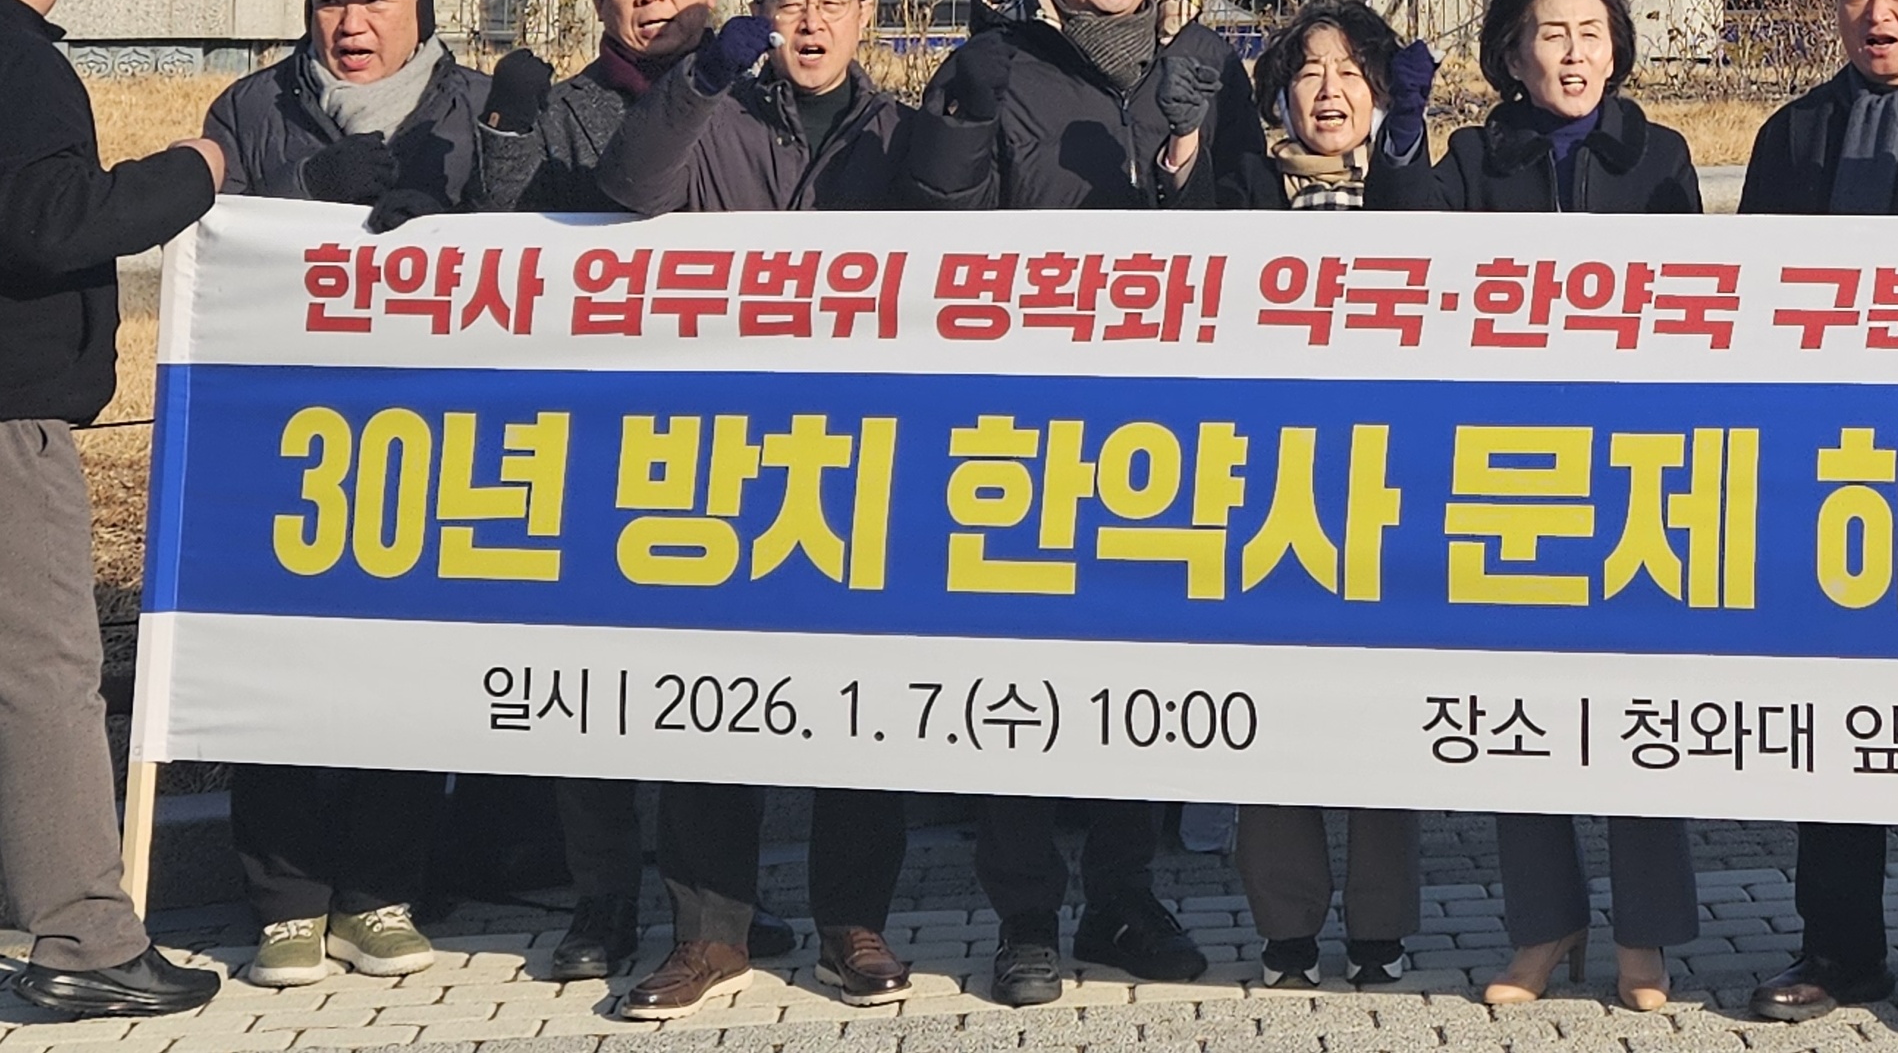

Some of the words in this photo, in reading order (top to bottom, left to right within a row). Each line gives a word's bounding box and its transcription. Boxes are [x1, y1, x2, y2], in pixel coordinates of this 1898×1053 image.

[305, 244, 543, 334] 한약사
[572, 250, 906, 338] 업무범위
[935, 253, 1226, 342] 명확화!
[275, 406, 568, 579] 30년
[618, 414, 895, 588] 방치
[949, 415, 1399, 599] 한약사
[1446, 425, 1757, 607] 문제
[484, 668, 588, 733] 일시
[655, 675, 811, 738] 2026.
[841, 681, 884, 740] 1.
[909, 679, 1059, 751] 7.(수)
[1091, 689, 1256, 749] 10:00
[1423, 696, 1550, 763] 장소
[1621, 699, 1813, 772] 청와대
